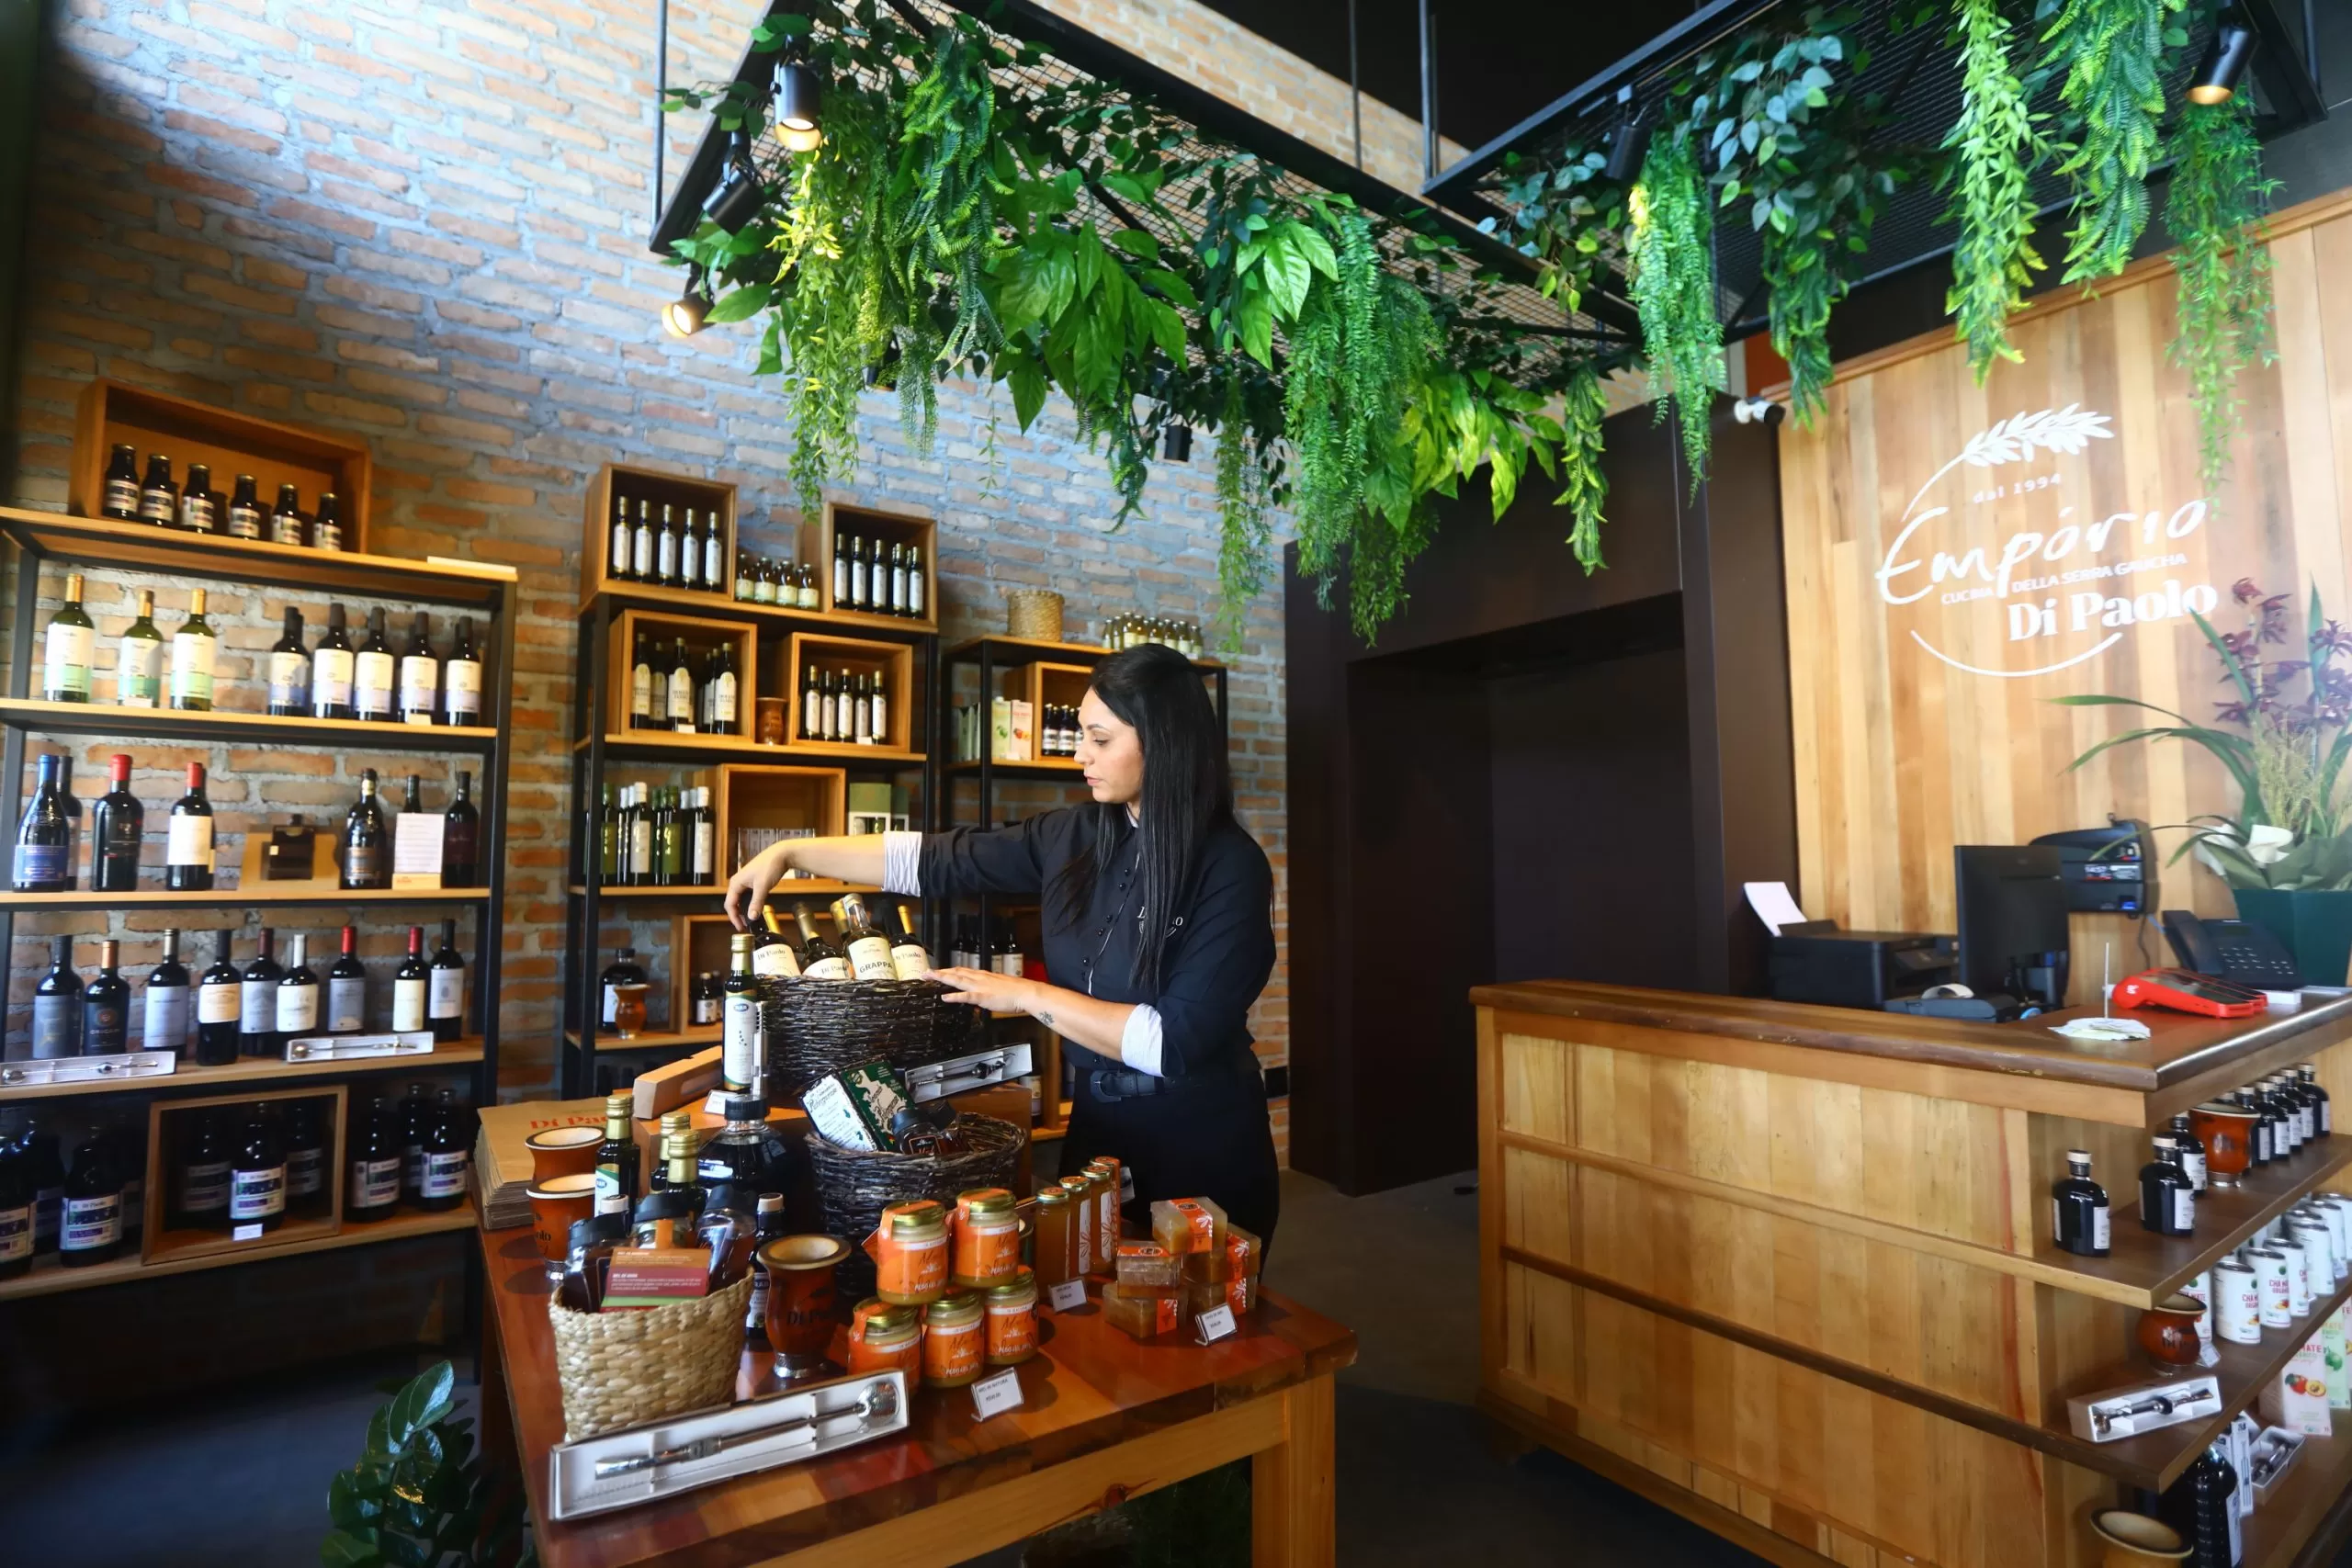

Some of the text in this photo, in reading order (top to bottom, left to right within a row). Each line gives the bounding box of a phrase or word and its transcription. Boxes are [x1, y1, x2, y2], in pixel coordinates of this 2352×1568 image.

[1973, 472, 2062, 503] dal 1994
[1874, 499, 2209, 604] Empório
[1940, 588, 1995, 604] CUCINA
[2011, 575, 2059, 592] DELLA
[2062, 566, 2113, 584] SERRA
[2008, 579, 2218, 641] Di Paolo
[859, 961, 893, 974] GRAPPA
[530, 1116, 607, 1129] Di Pao
